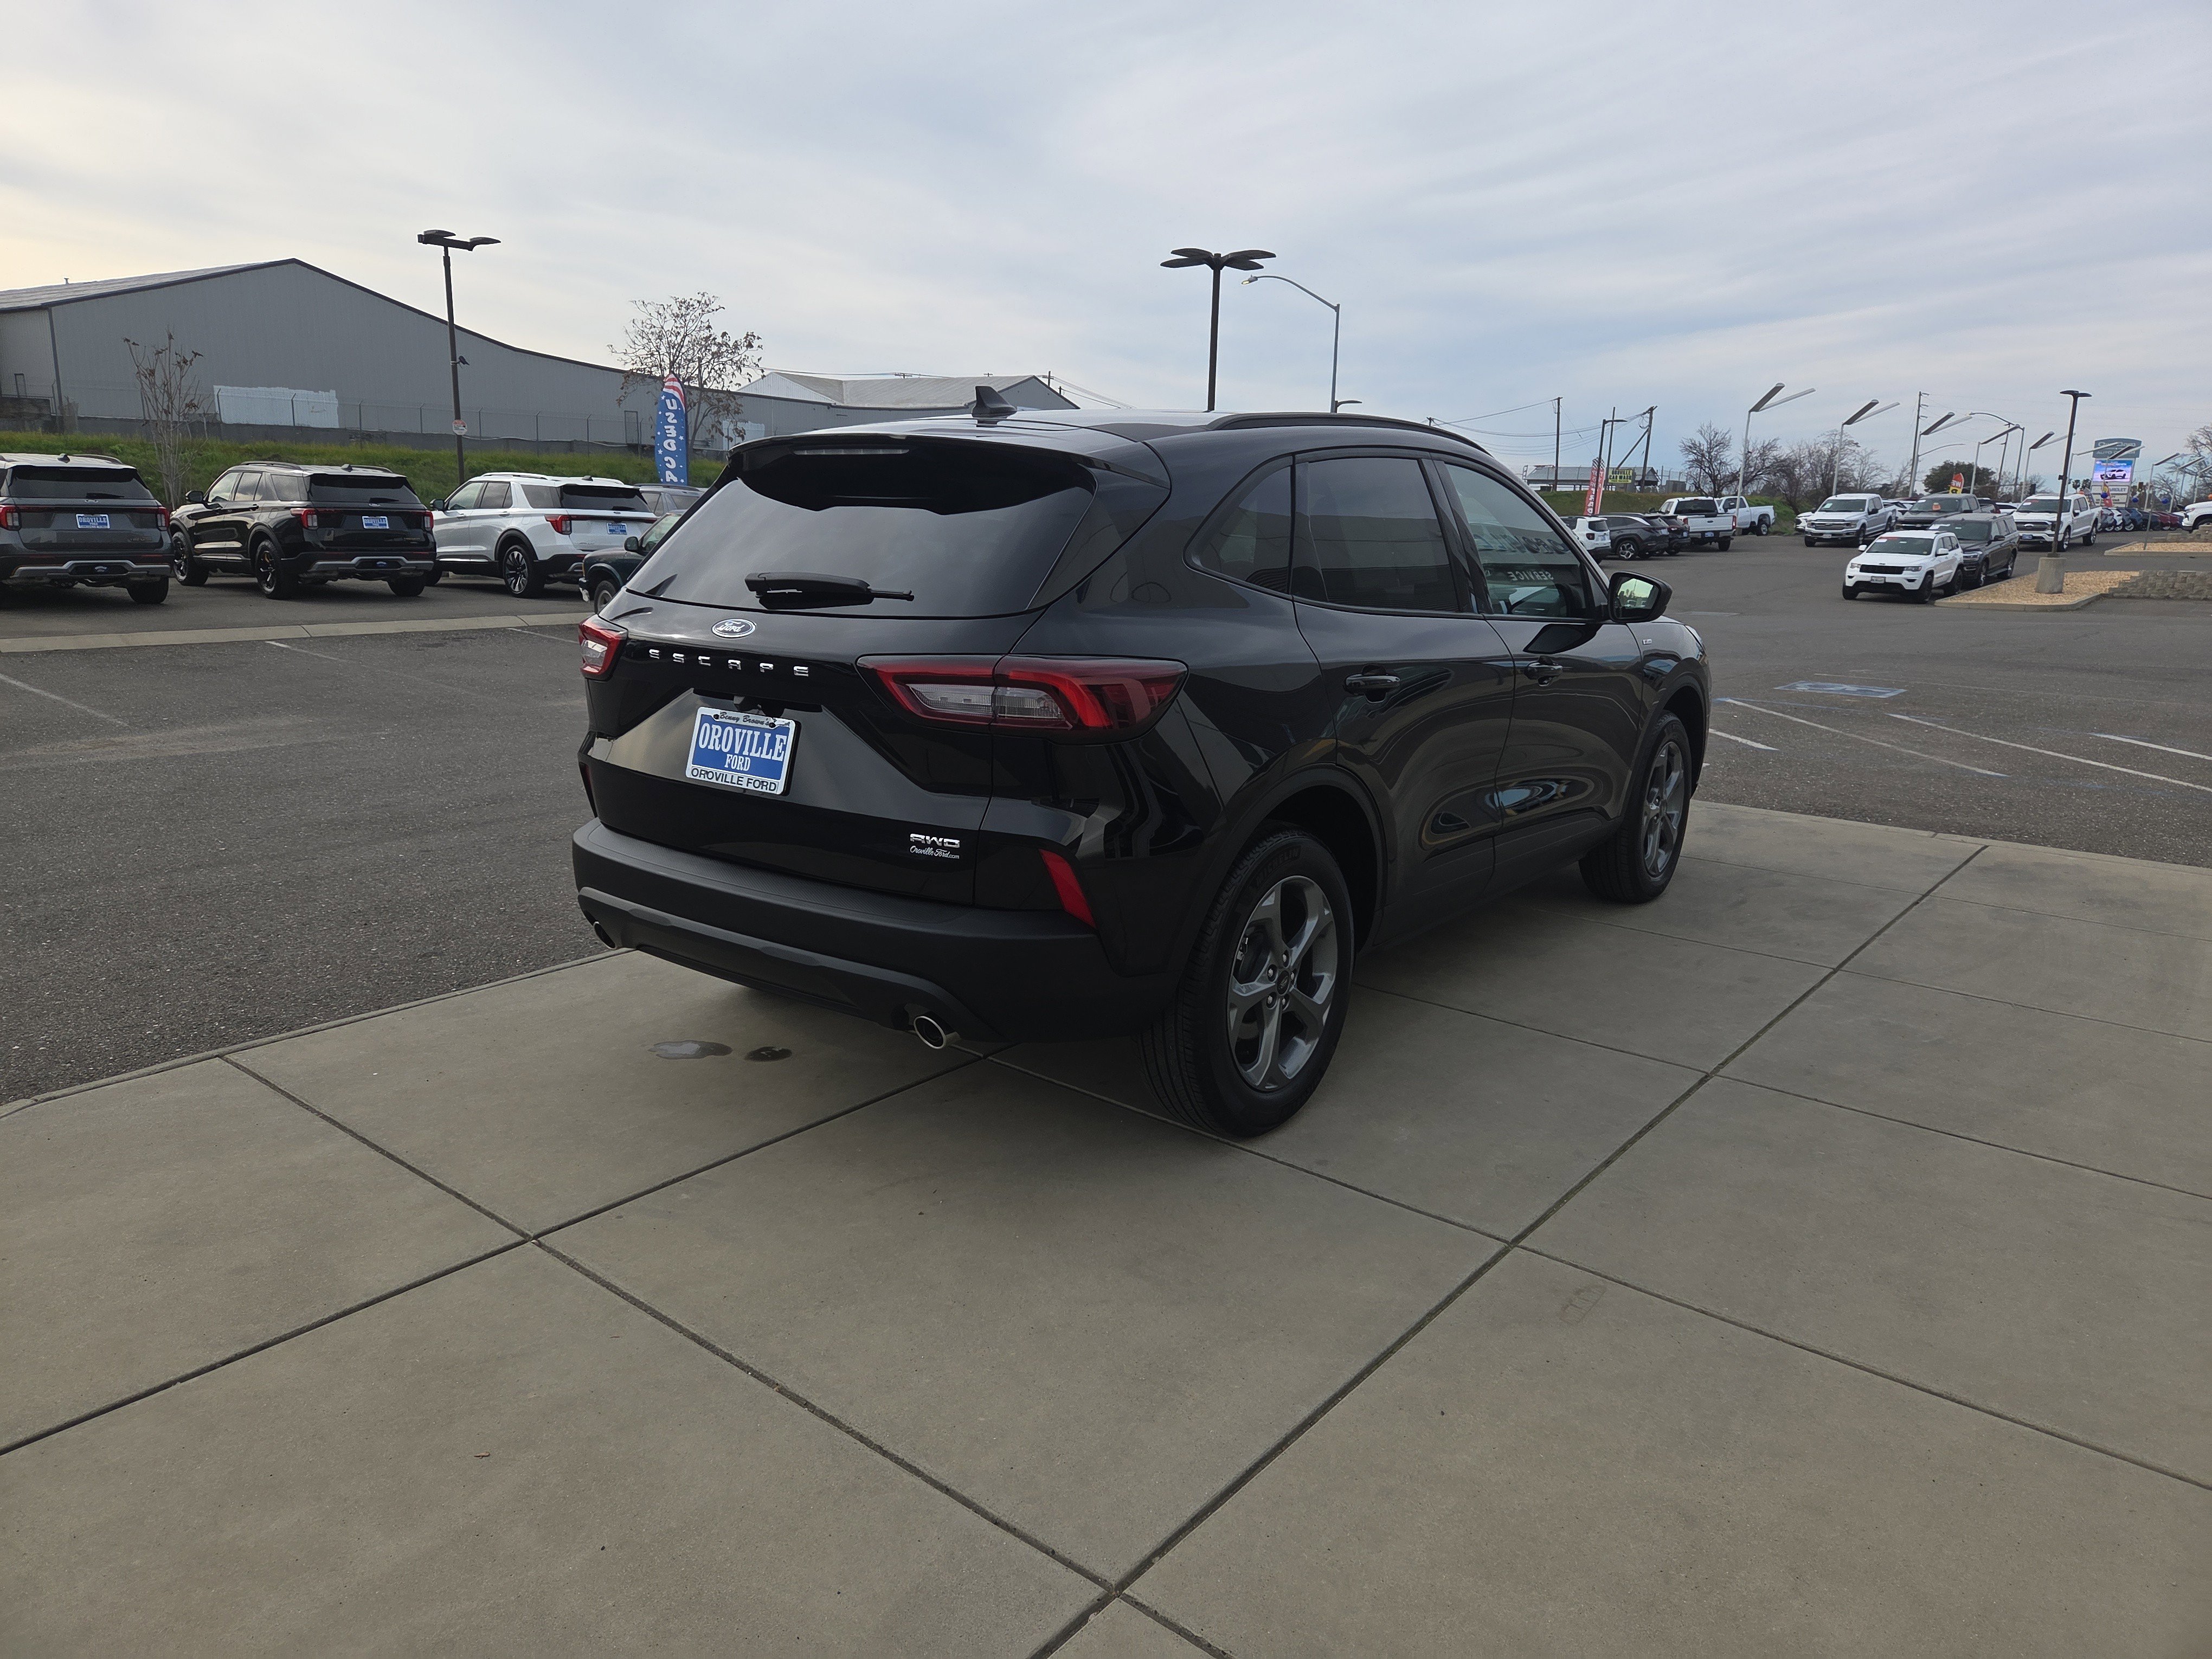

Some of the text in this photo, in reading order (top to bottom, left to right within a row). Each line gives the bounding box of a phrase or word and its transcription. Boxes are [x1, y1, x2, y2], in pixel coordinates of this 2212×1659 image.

[716, 620, 745, 633] Ford
[649, 649, 809, 677] ESCAPE
[719, 711, 770, 726] Benny Brown's
[698, 723, 787, 762] OROVILLE
[724, 754, 751, 771] FORD
[691, 768, 777, 792] OROVILLE FORD
[910, 834, 960, 848] AWD
[1257, 847, 1300, 884] MICHELIN
